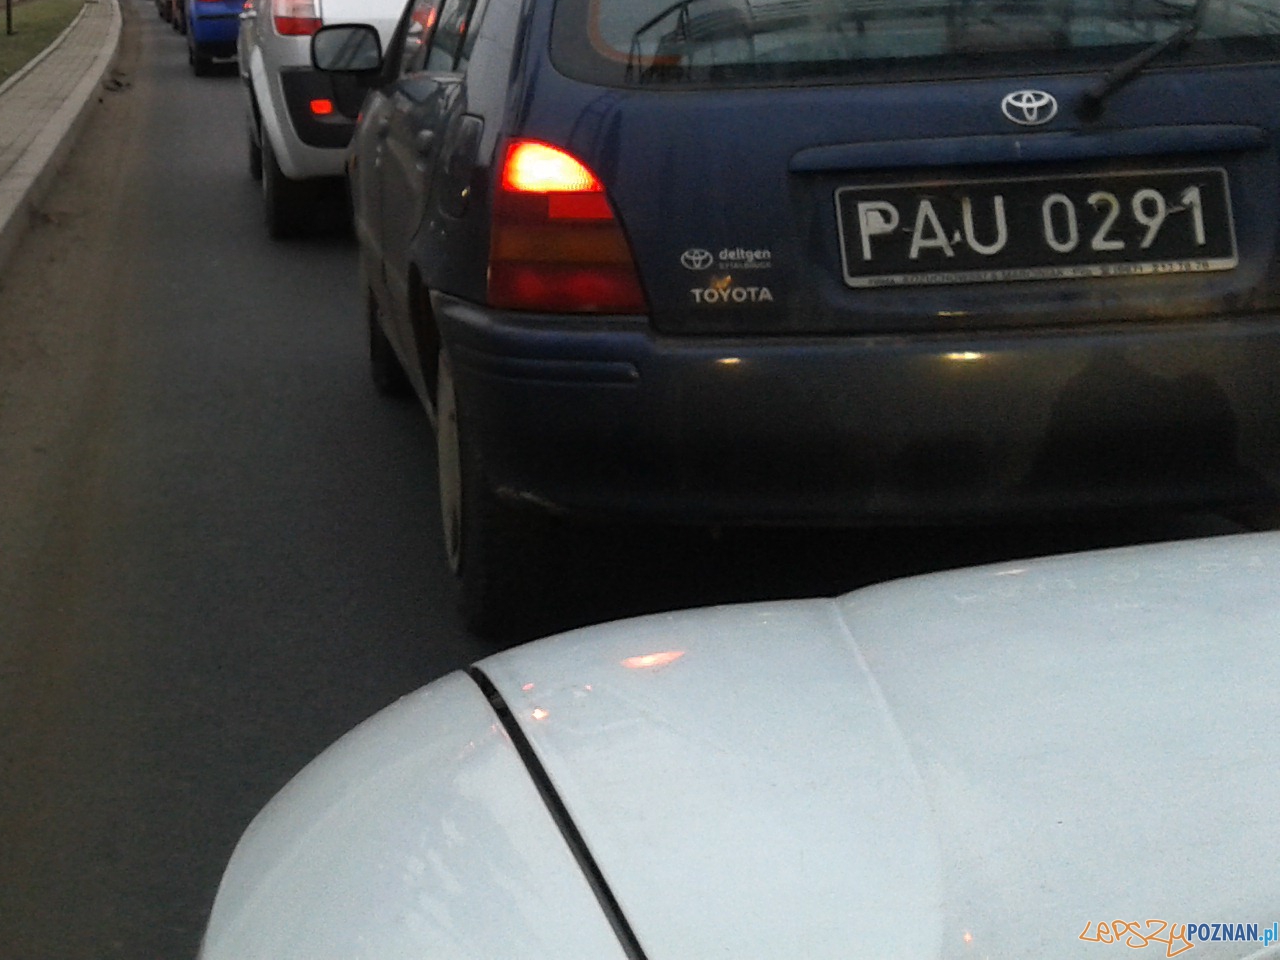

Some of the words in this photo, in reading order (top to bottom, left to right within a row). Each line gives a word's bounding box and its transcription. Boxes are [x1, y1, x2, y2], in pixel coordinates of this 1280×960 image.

[857, 195, 1008, 262] PAU
[1041, 186, 1206, 252] 0291
[690, 286, 773, 303] TOYOTA
